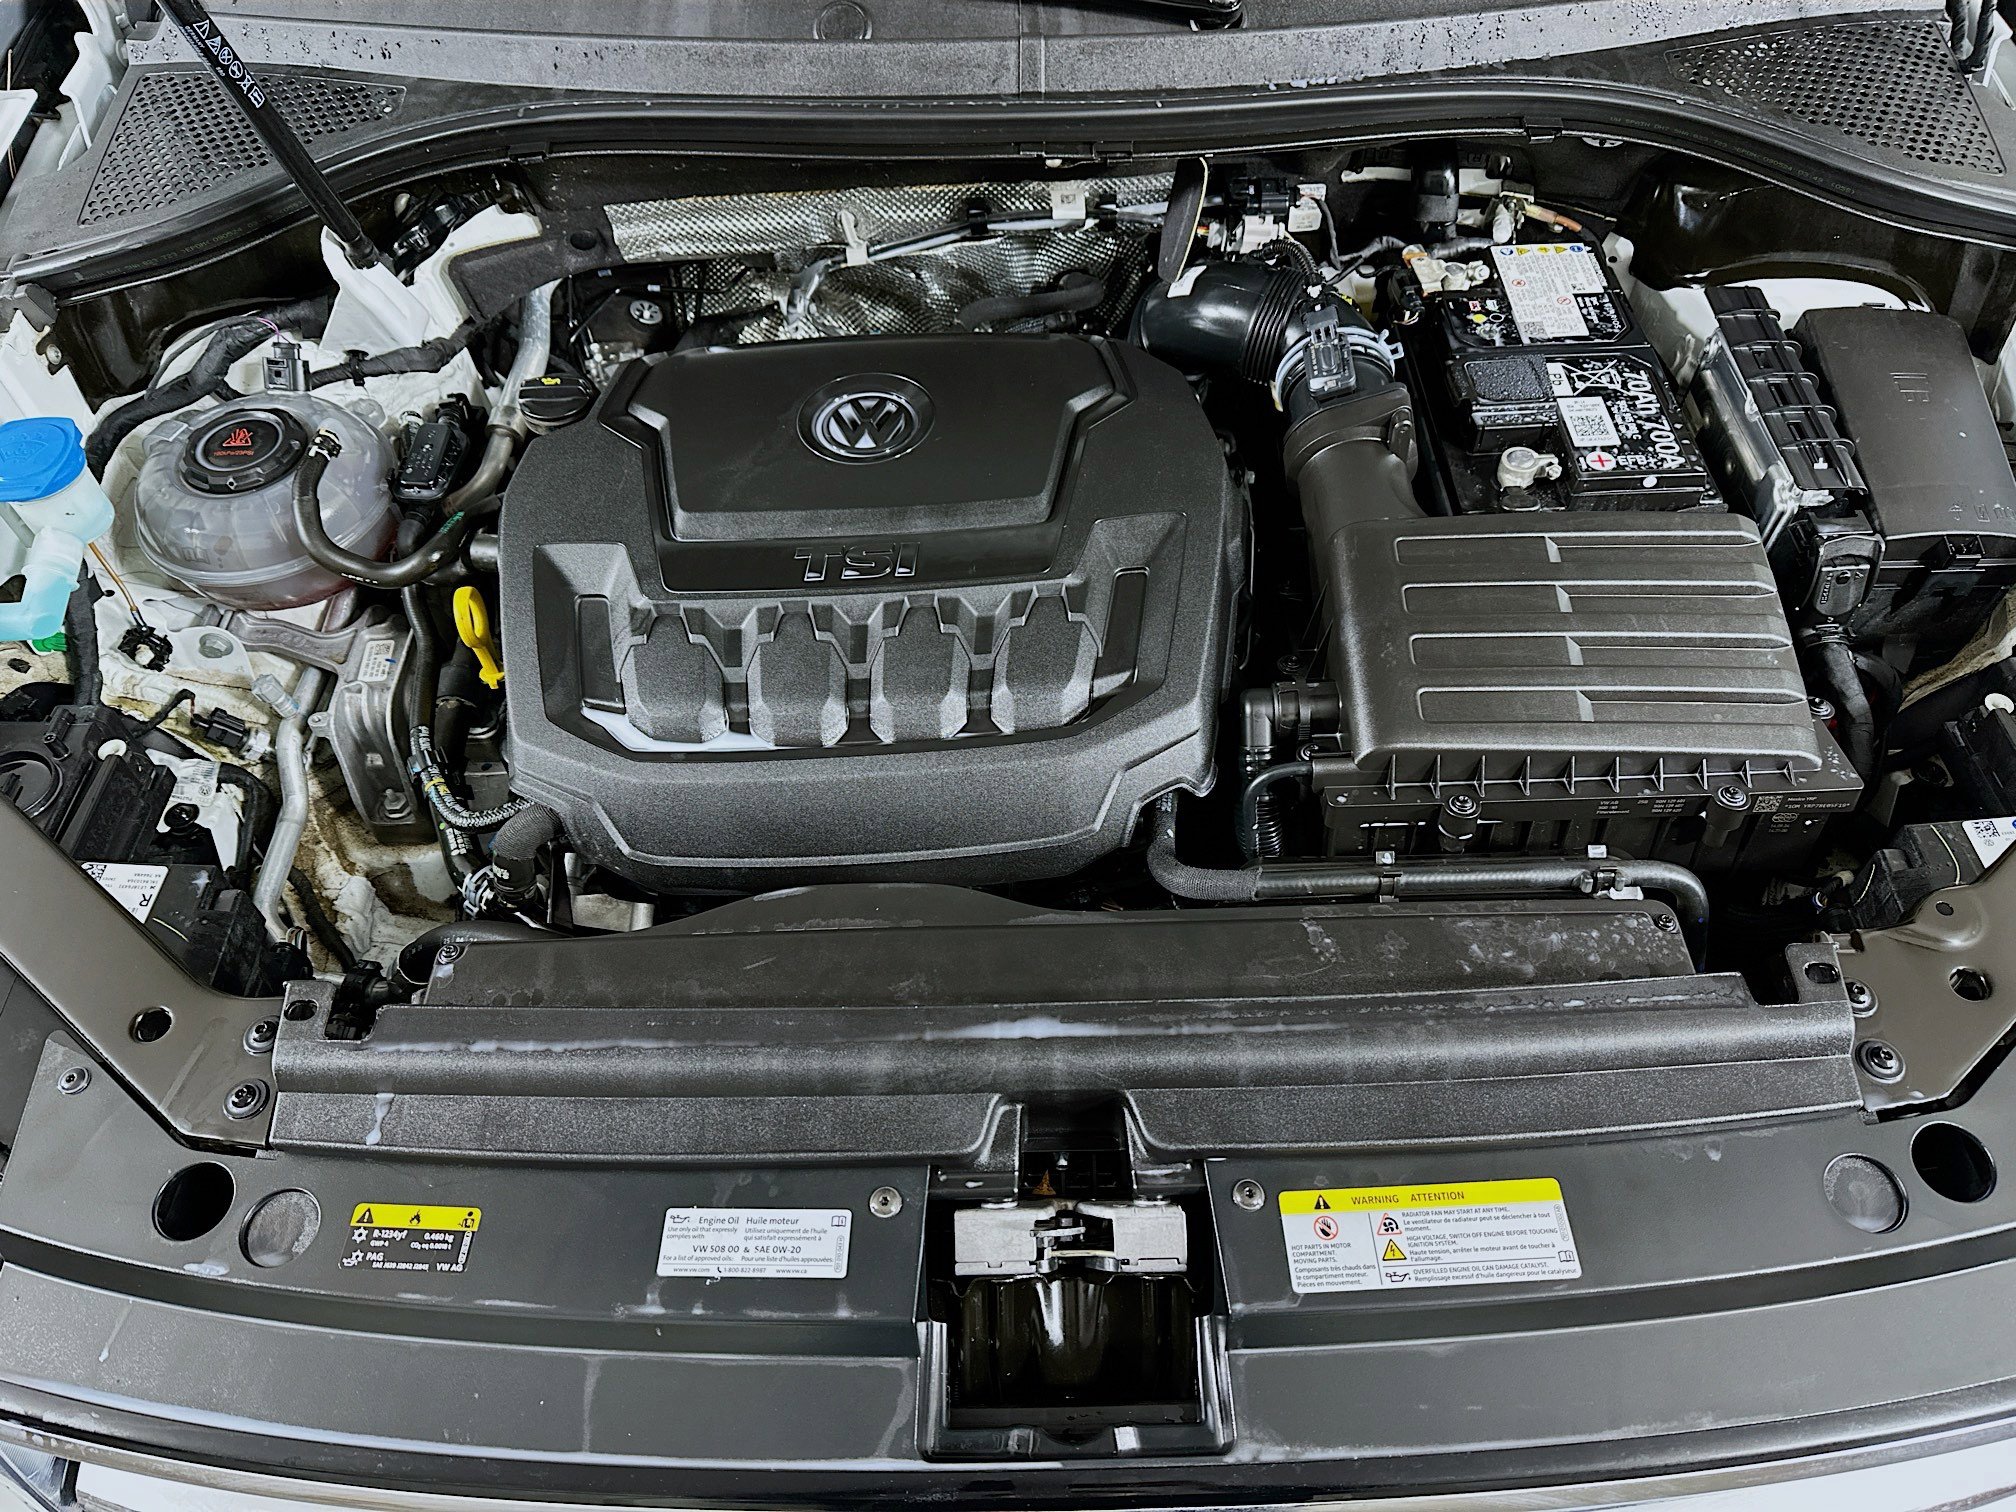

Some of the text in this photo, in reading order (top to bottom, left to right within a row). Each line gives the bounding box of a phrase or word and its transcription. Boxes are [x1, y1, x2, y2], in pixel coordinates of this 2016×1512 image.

[1549, 374, 1564, 385] Pb
[814, 393, 918, 457] VW
[1623, 370, 1661, 415] 70Ah
[1642, 418, 1686, 469] 700A
[794, 542, 920, 581] TSI
[139, 894, 152, 906] R
[1351, 1191, 1465, 1205] WARNING ATTENTION
[699, 1216, 739, 1226] Engine Oil
[373, 1229, 408, 1241] R-1234yf
[366, 1252, 384, 1261] PAG
[1303, 1272, 1344, 1280] compartiment
[1413, 1267, 1448, 1275] OVERFILLED
[1414, 1274, 1451, 1282] Remplissage
[1496, 1271, 1526, 1279] dangereux
